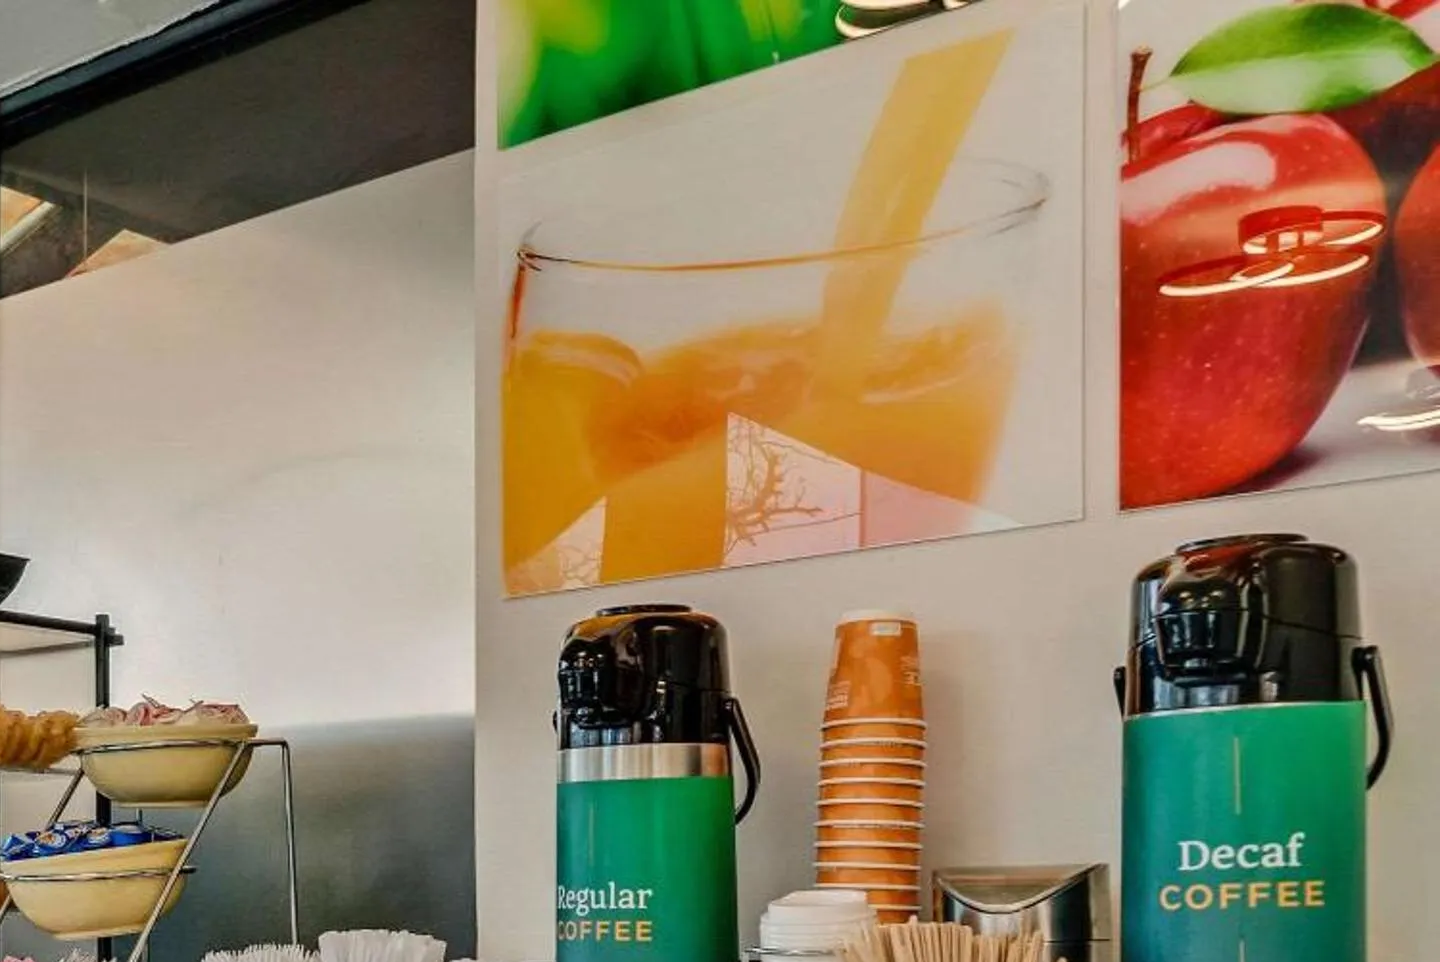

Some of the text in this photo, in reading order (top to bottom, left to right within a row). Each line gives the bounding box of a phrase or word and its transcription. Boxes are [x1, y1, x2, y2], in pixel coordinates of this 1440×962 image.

[1176, 831, 1306, 872] Decaf
[557, 881, 654, 916] Regular
[1159, 880, 1326, 911] COFFEE
[557, 920, 653, 942] COFFEE
